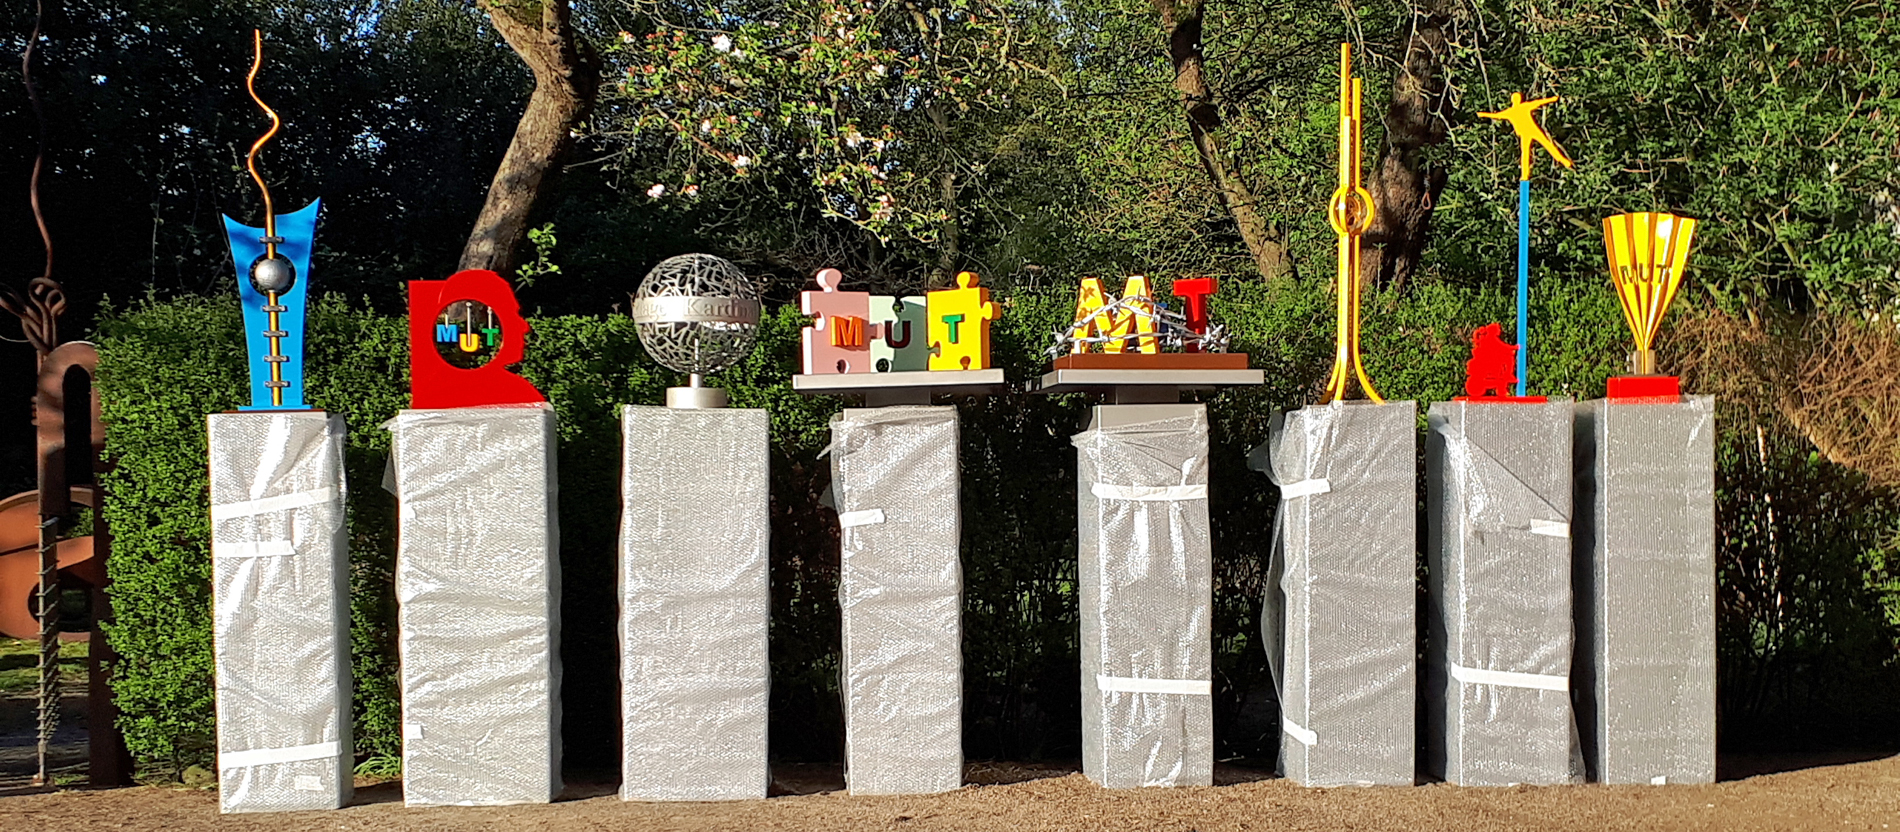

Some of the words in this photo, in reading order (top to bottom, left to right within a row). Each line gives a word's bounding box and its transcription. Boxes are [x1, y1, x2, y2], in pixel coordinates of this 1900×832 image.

[1620, 263, 1672, 285] MUT
[436, 324, 499, 352] MUT
[830, 314, 965, 348] MUT
